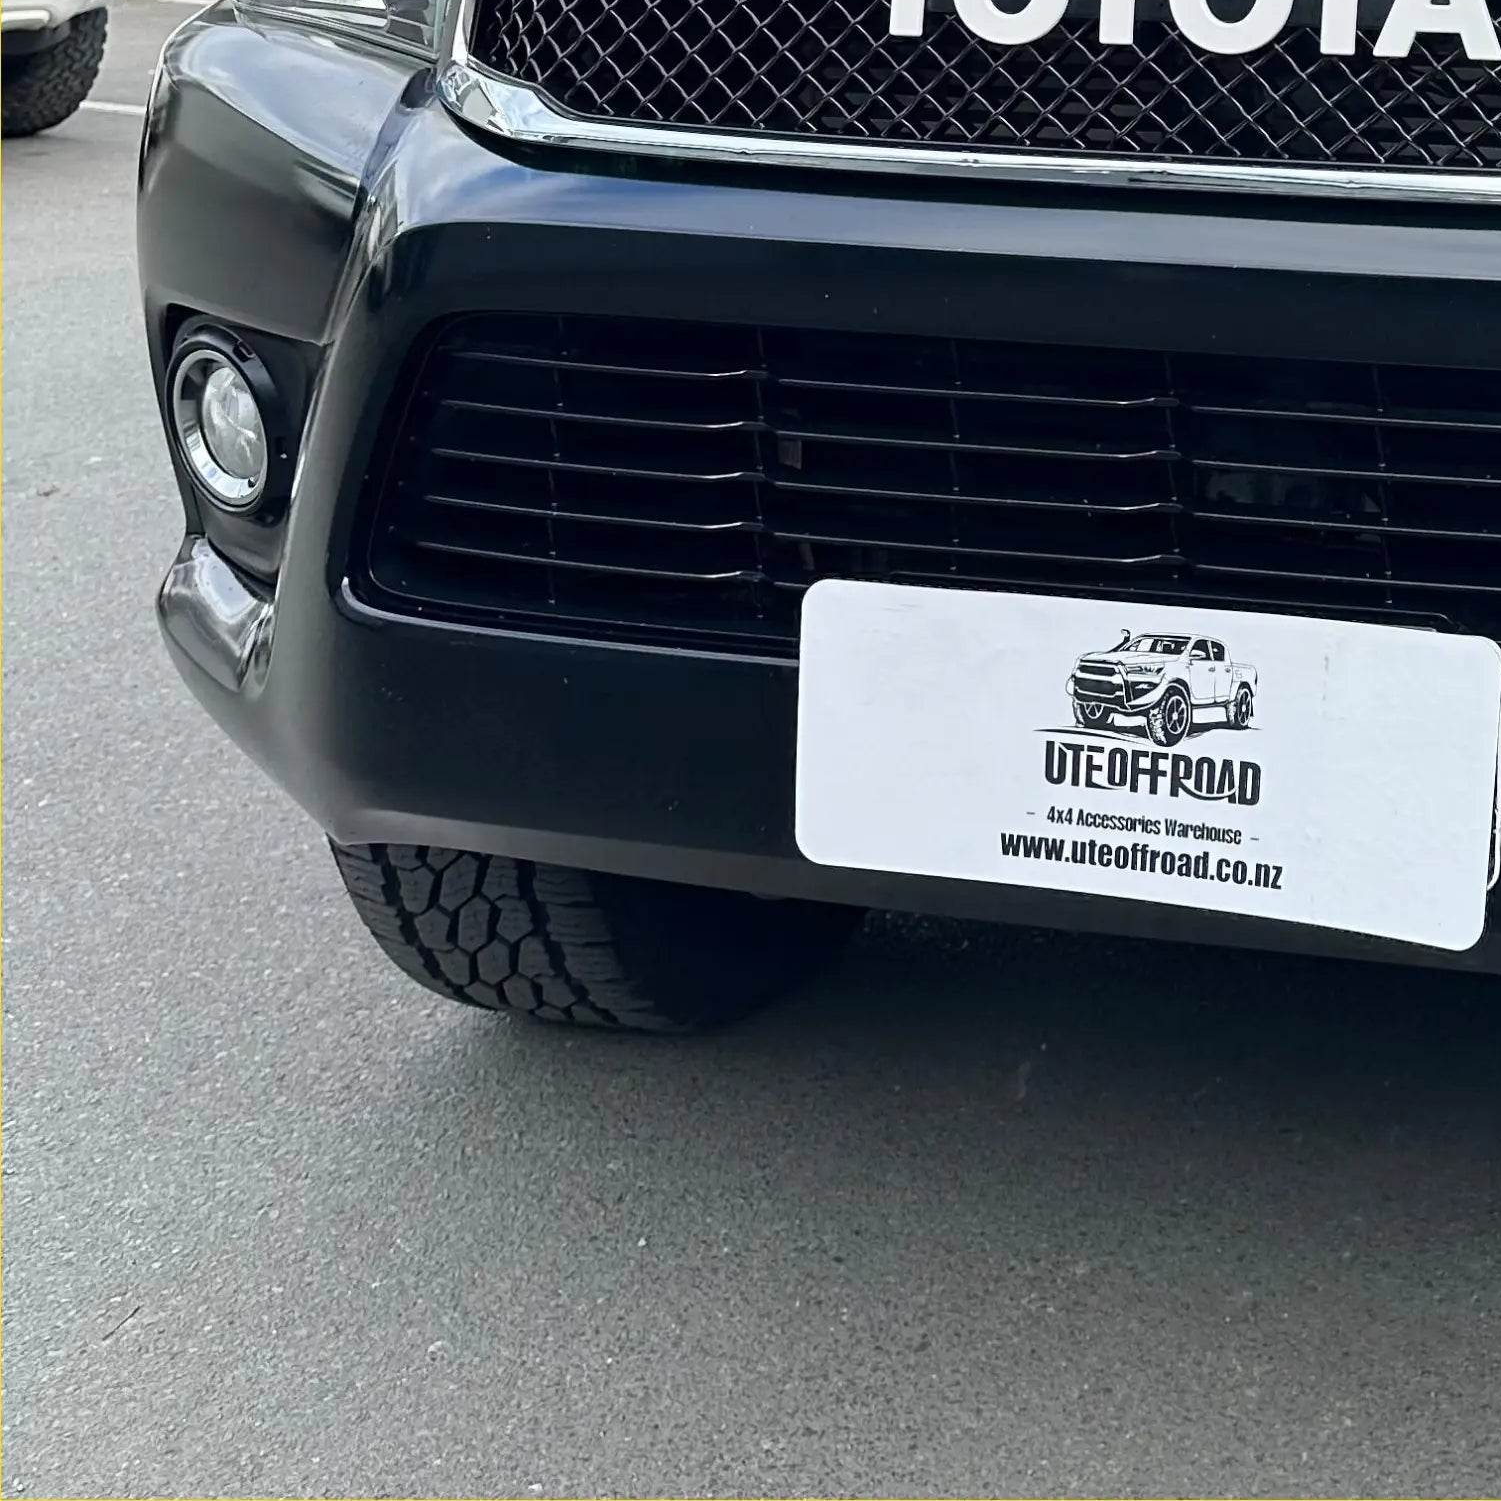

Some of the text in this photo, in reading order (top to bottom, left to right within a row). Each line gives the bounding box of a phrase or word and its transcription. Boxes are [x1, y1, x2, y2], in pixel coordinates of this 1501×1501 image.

[1044, 740, 1262, 806] UTEOFFROAD
[1047, 806, 1242, 845] 4x4 Accessories Warehouse
[1000, 832, 1284, 890] www.uteoffroad.co.nz
